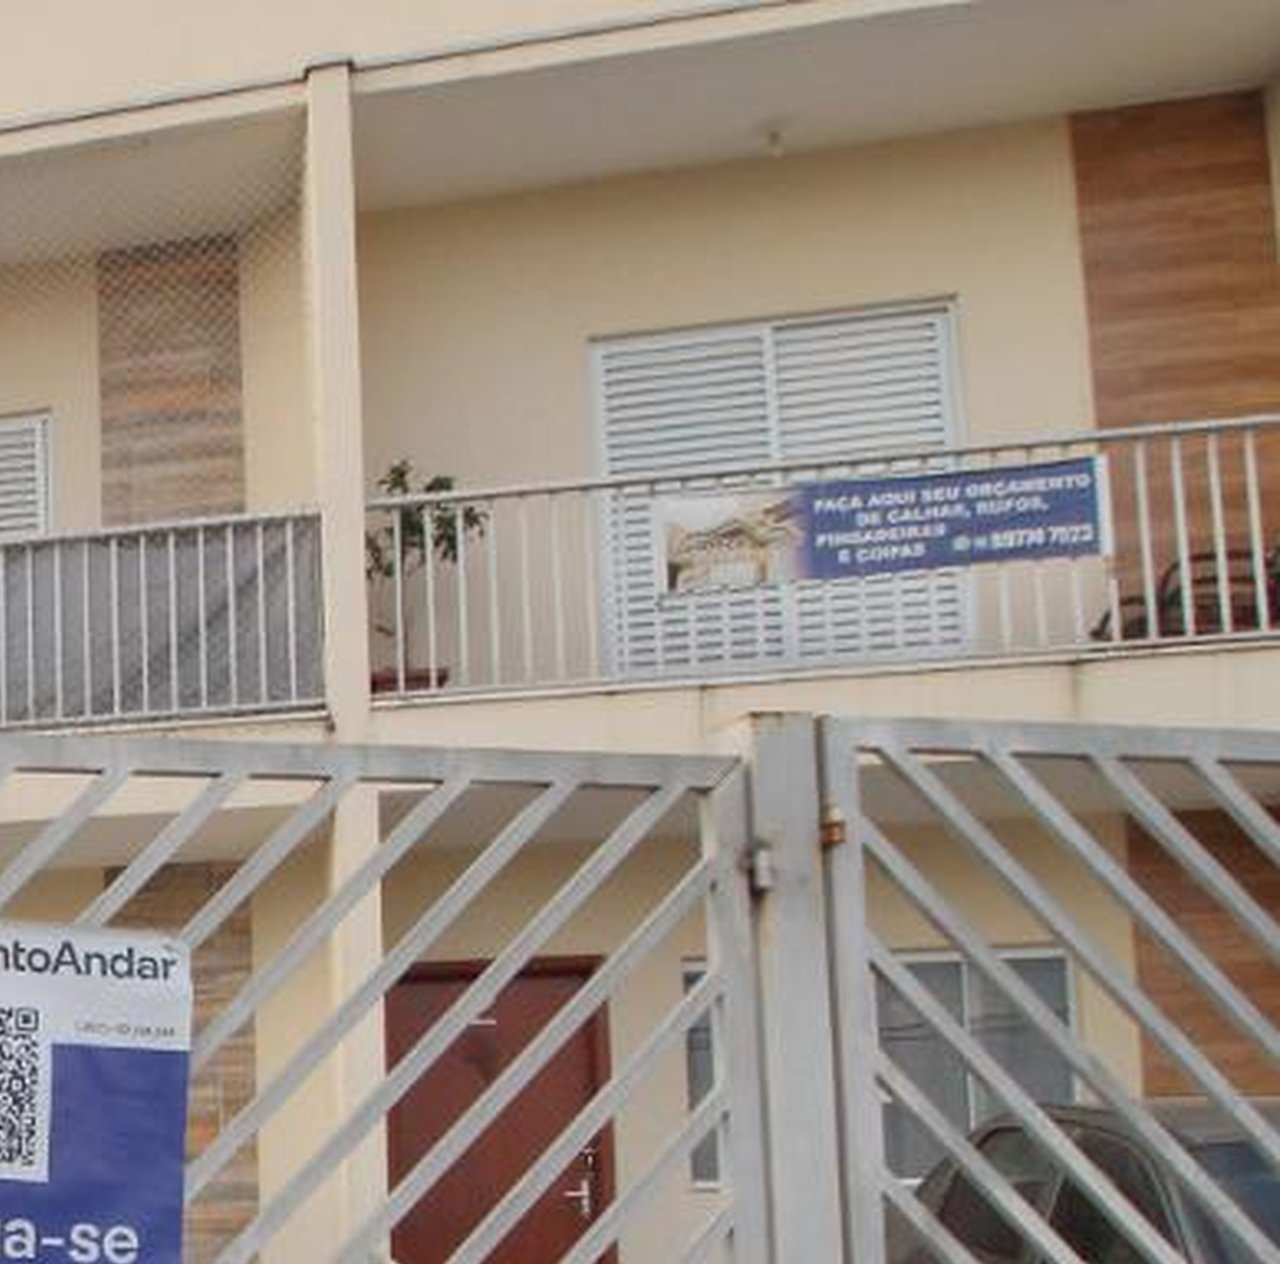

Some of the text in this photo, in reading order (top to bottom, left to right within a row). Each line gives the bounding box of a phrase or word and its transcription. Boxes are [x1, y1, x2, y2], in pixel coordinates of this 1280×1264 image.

[868, 490, 916, 507] AQUI
[921, 486, 959, 503] SEU
[855, 511, 881, 527] DE
[838, 548, 851, 565] E
